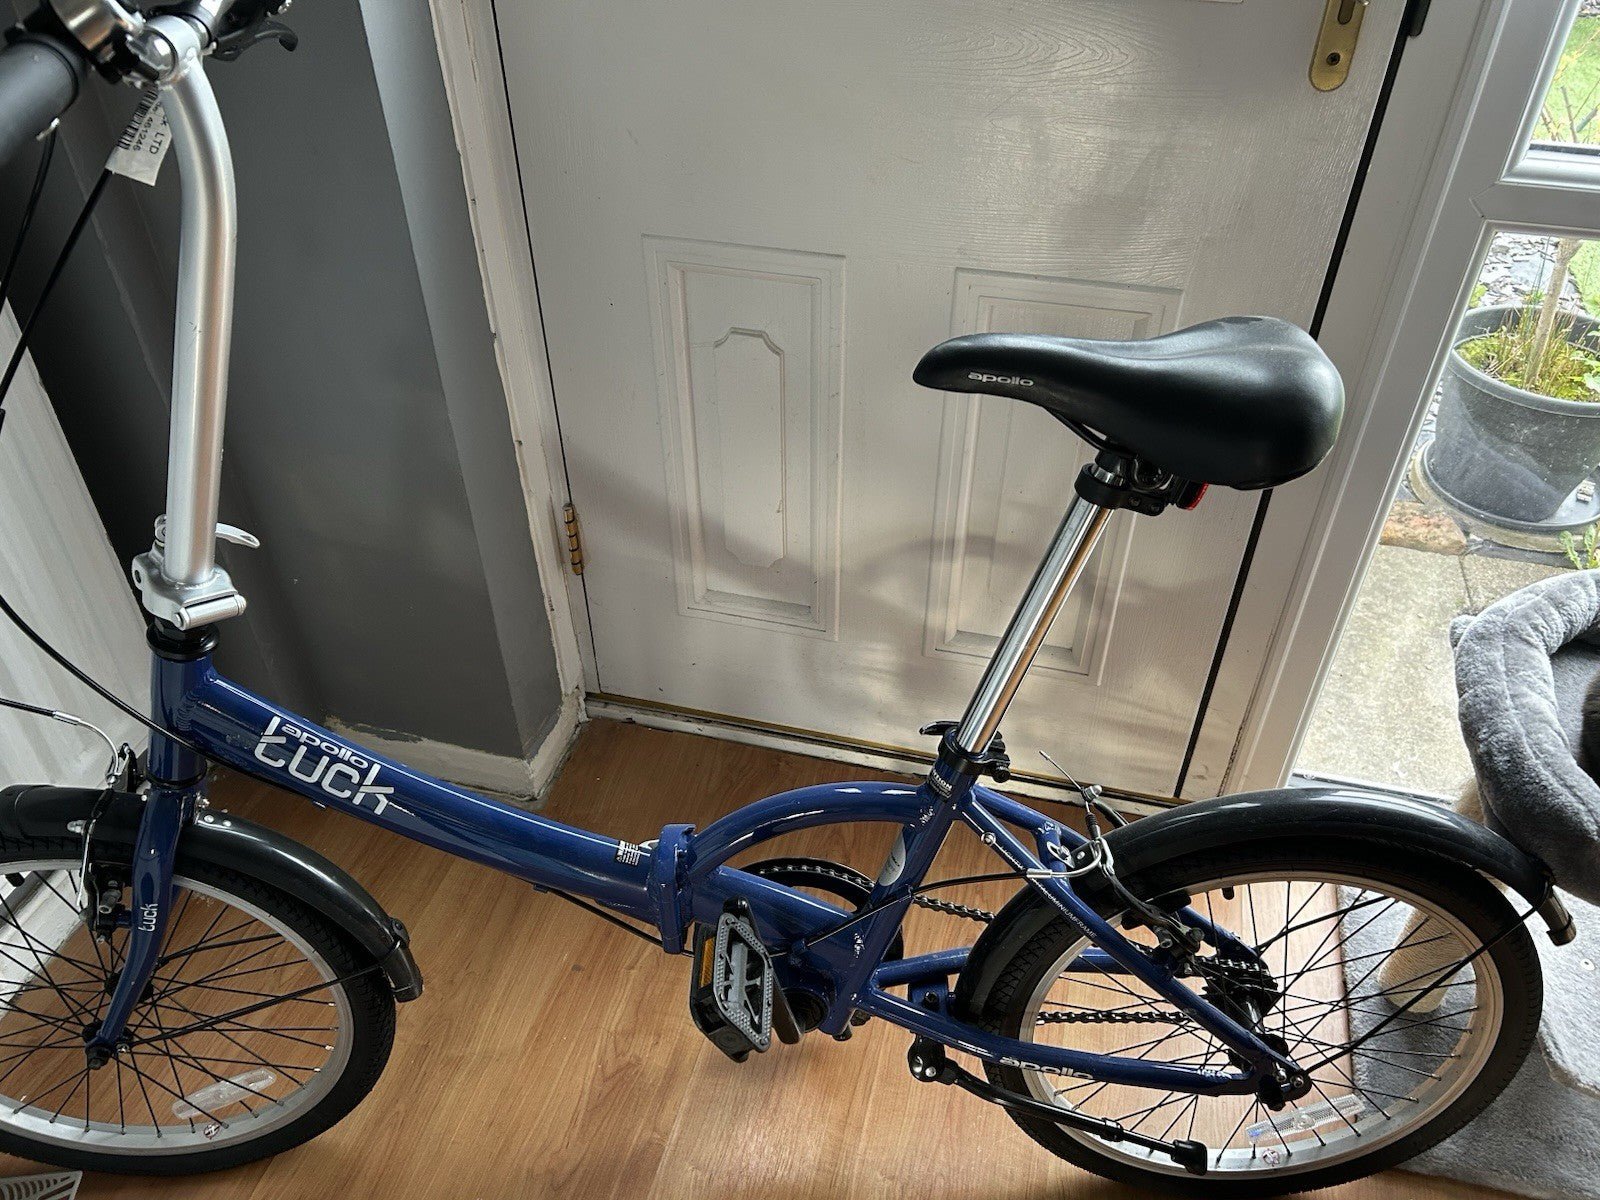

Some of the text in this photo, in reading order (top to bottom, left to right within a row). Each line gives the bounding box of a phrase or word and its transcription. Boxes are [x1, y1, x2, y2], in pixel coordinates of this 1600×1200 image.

[149, 132, 165, 154] LTD
[968, 372, 1034, 387] apollo
[281, 723, 369, 769] apollo
[254, 715, 395, 816] tuck
[138, 903, 159, 932] tuck
